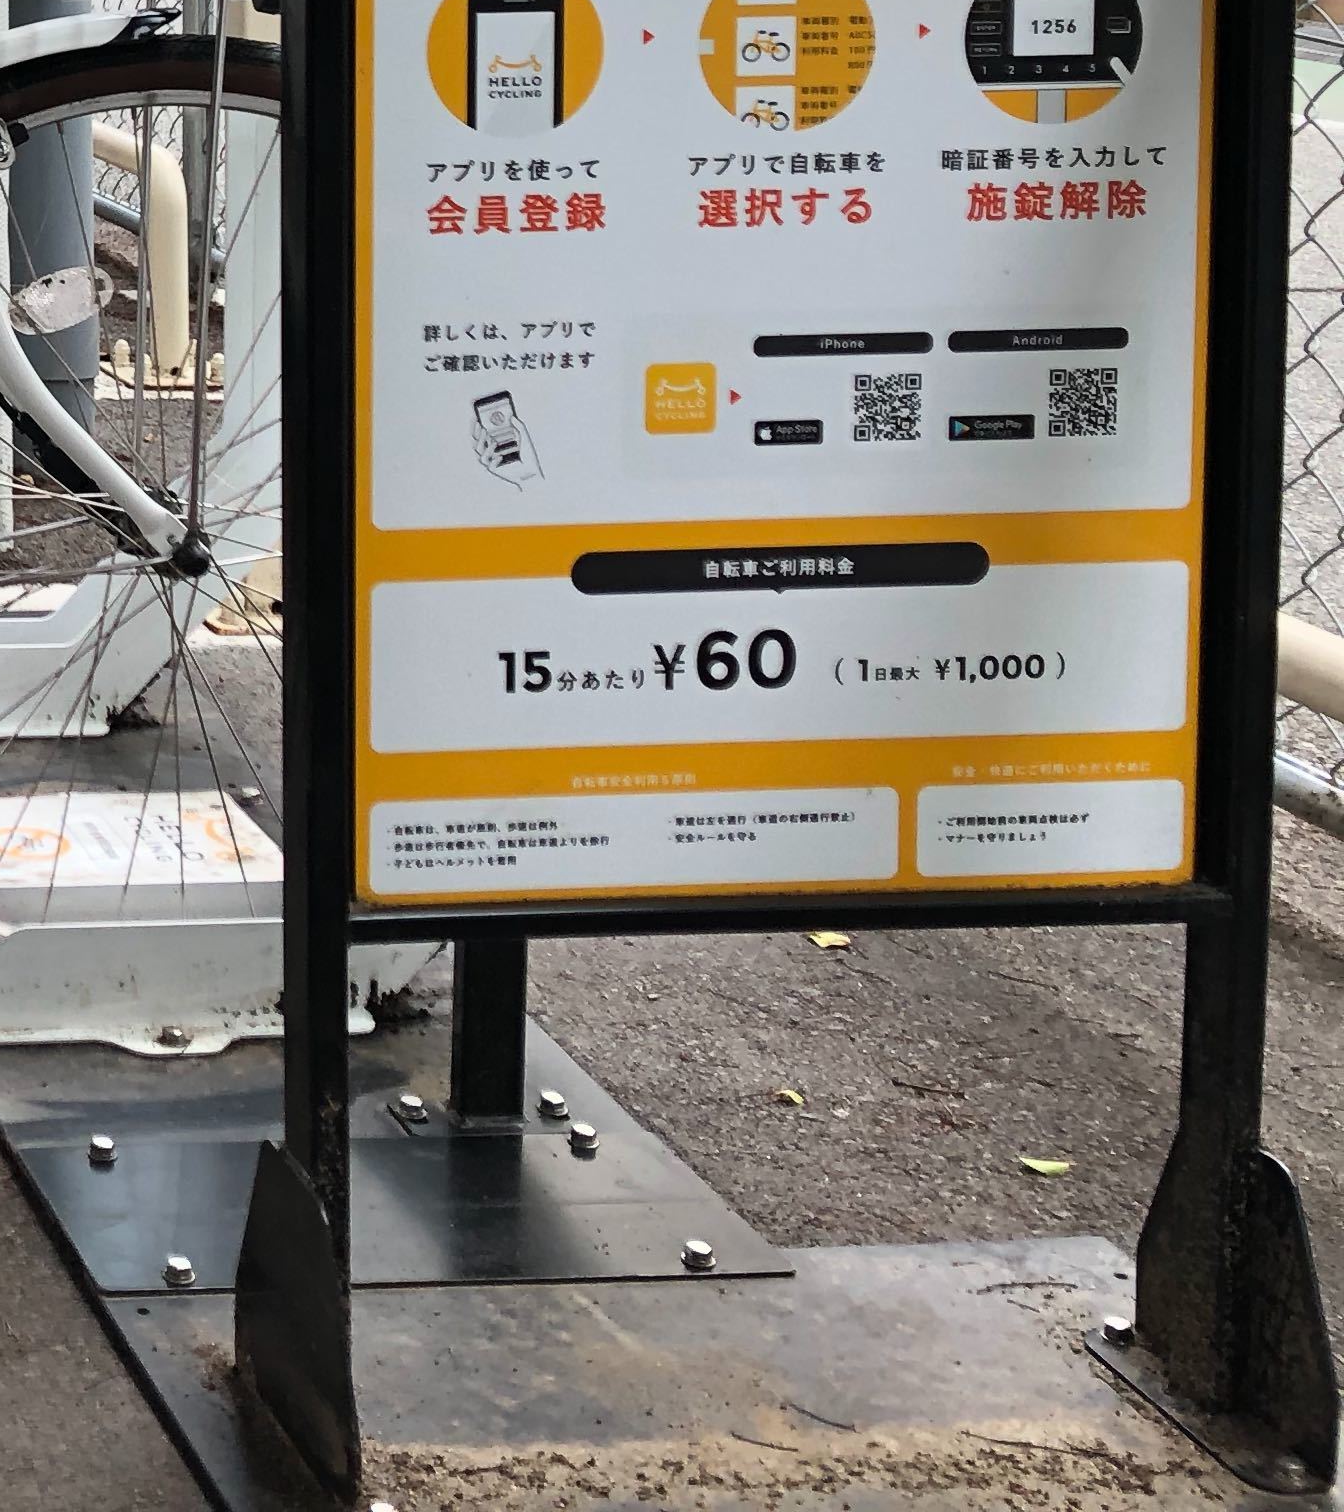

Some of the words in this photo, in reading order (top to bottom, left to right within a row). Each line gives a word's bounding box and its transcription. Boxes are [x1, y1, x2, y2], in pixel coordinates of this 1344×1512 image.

[1031, 19, 1077, 34] 1256
[488, 76, 543, 88] HELLO
[488, 89, 543, 99] CYCLING
[687, 150, 887, 176] アプリで自転車を
[941, 144, 1168, 171] 暗証番号を入力して
[425, 158, 600, 183] アプリを使って
[697, 187, 875, 228] 選択する
[965, 180, 1149, 222] 施錠解除
[426, 192, 607, 234] 会員登録
[424, 321, 596, 343] 詳しくは、アプリで
[1012, 334, 1063, 347] Android
[819, 337, 865, 350] iPhone
[424, 352, 595, 372] ご確認いただけます
[655, 397, 706, 410] HELLO
[704, 556, 856, 580] 自転車ご利用料金
